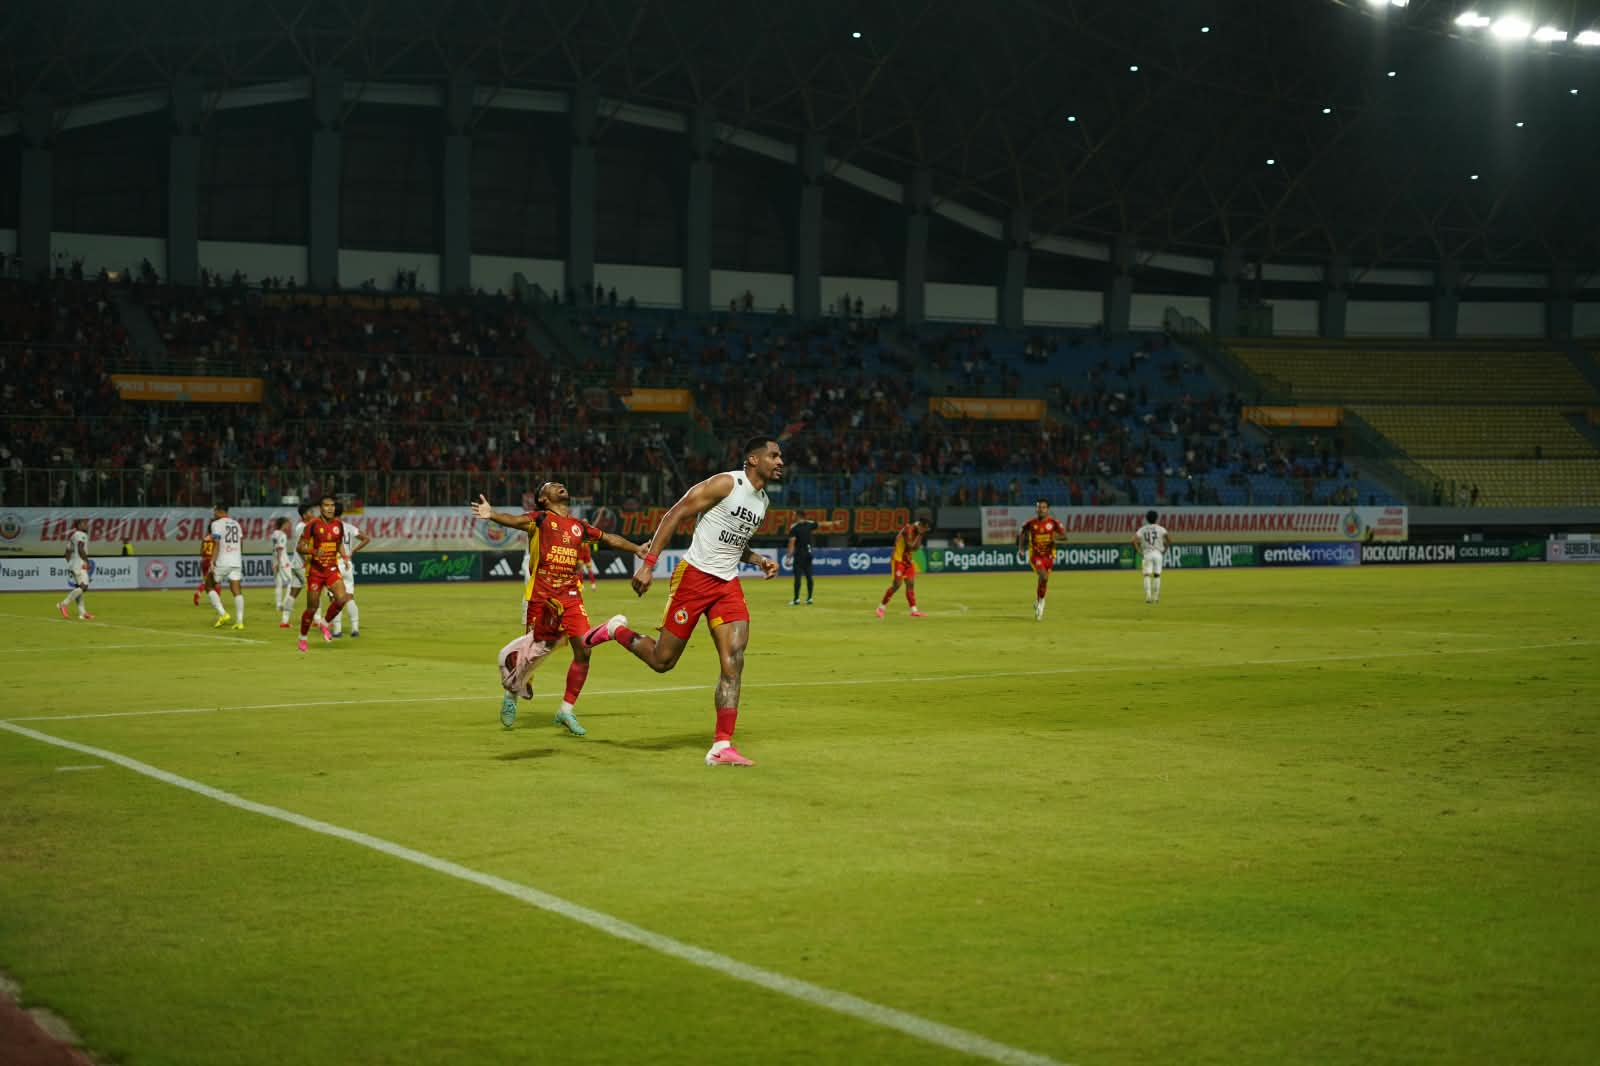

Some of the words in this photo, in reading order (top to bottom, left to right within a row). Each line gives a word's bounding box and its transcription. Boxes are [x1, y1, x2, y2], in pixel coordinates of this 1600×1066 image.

[225, 525, 239, 543] 28
[945, 550, 1014, 570] Pegadaian
[1162, 546, 1182, 567] AR
[1208, 545, 1232, 567] VAR
[1387, 545, 1408, 561] OUT
[1408, 545, 1456, 560] RACISM
[2, 566, 40, 580] Nagari
[95, 565, 131, 576] Nagari
[361, 562, 397, 575] EMAS
[400, 562, 413, 575] DI
